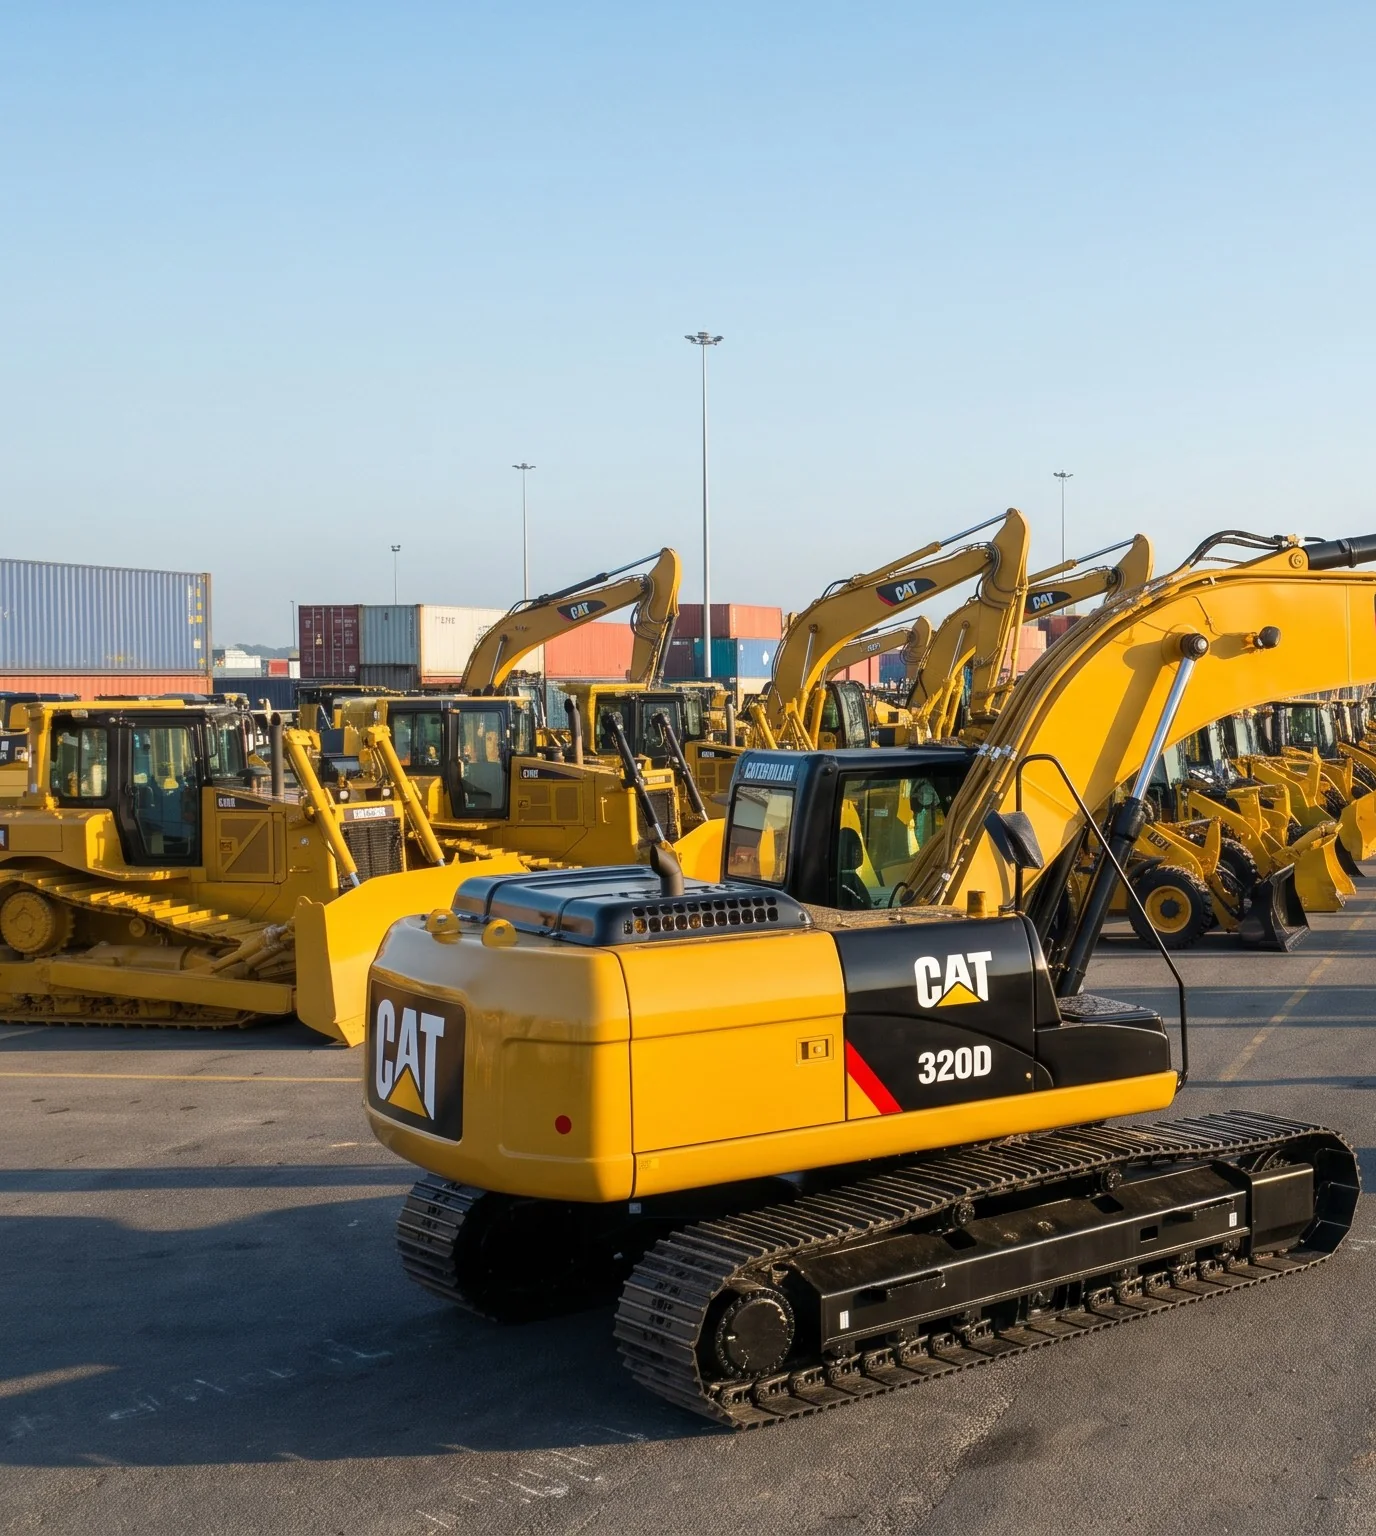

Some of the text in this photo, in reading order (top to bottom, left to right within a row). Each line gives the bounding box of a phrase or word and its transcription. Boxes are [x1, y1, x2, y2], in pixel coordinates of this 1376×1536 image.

[895, 580, 917, 601] CAT
[914, 951, 993, 1008] CAT
[376, 999, 445, 1120] CAT
[918, 1045, 992, 1085] 320D
